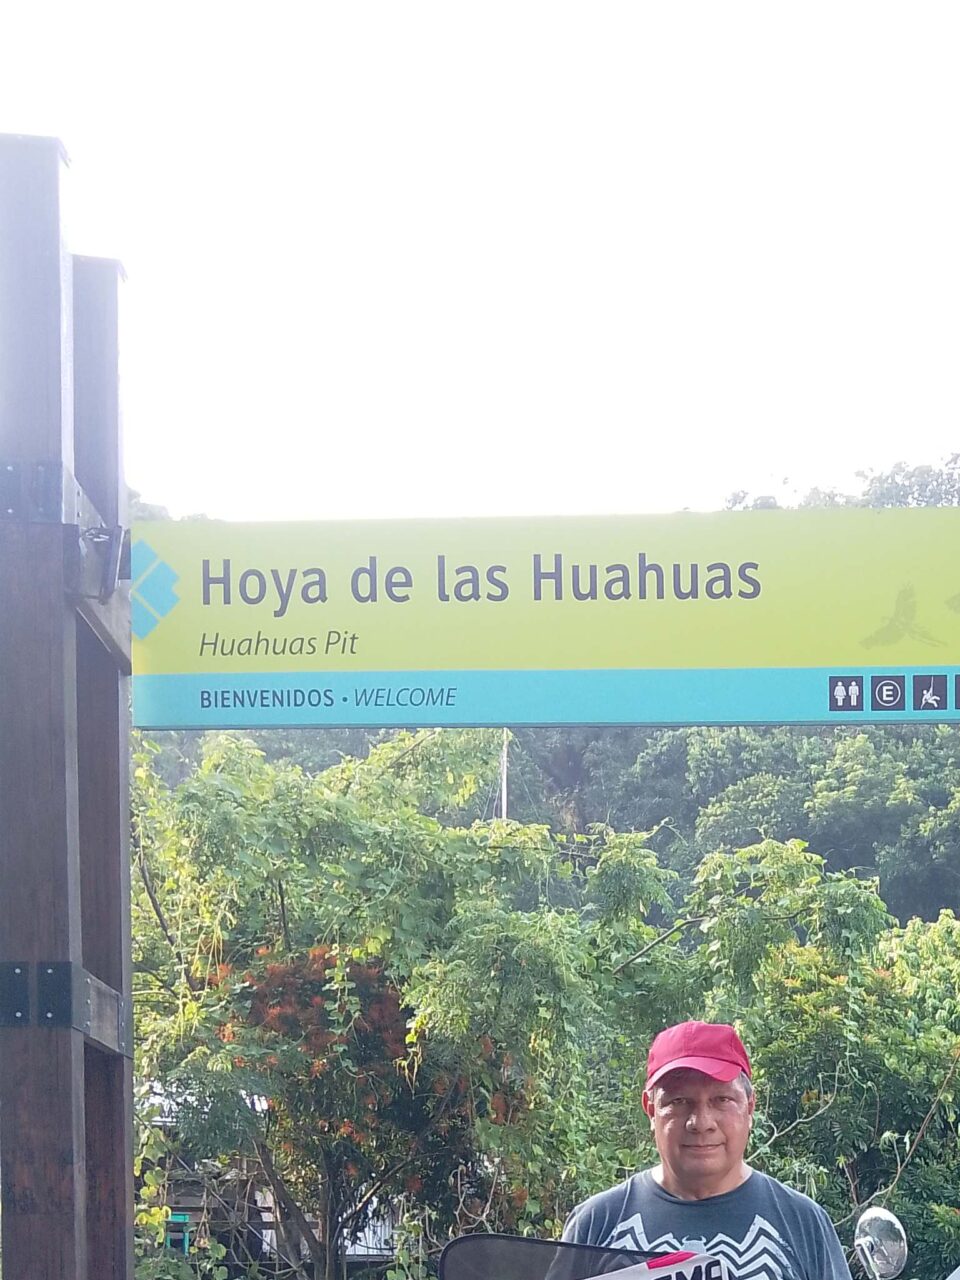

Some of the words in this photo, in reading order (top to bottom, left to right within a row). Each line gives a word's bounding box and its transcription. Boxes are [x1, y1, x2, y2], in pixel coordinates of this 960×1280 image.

[202, 558, 328, 617] Hoya
[350, 556, 413, 603] de
[437, 555, 509, 602] las
[533, 552, 761, 600] Huahuas
[199, 631, 317, 656] Huahuas
[325, 630, 359, 655] Pit
[200, 689, 334, 708] BIENVENIDOS
[354, 688, 457, 707] WELCOME
